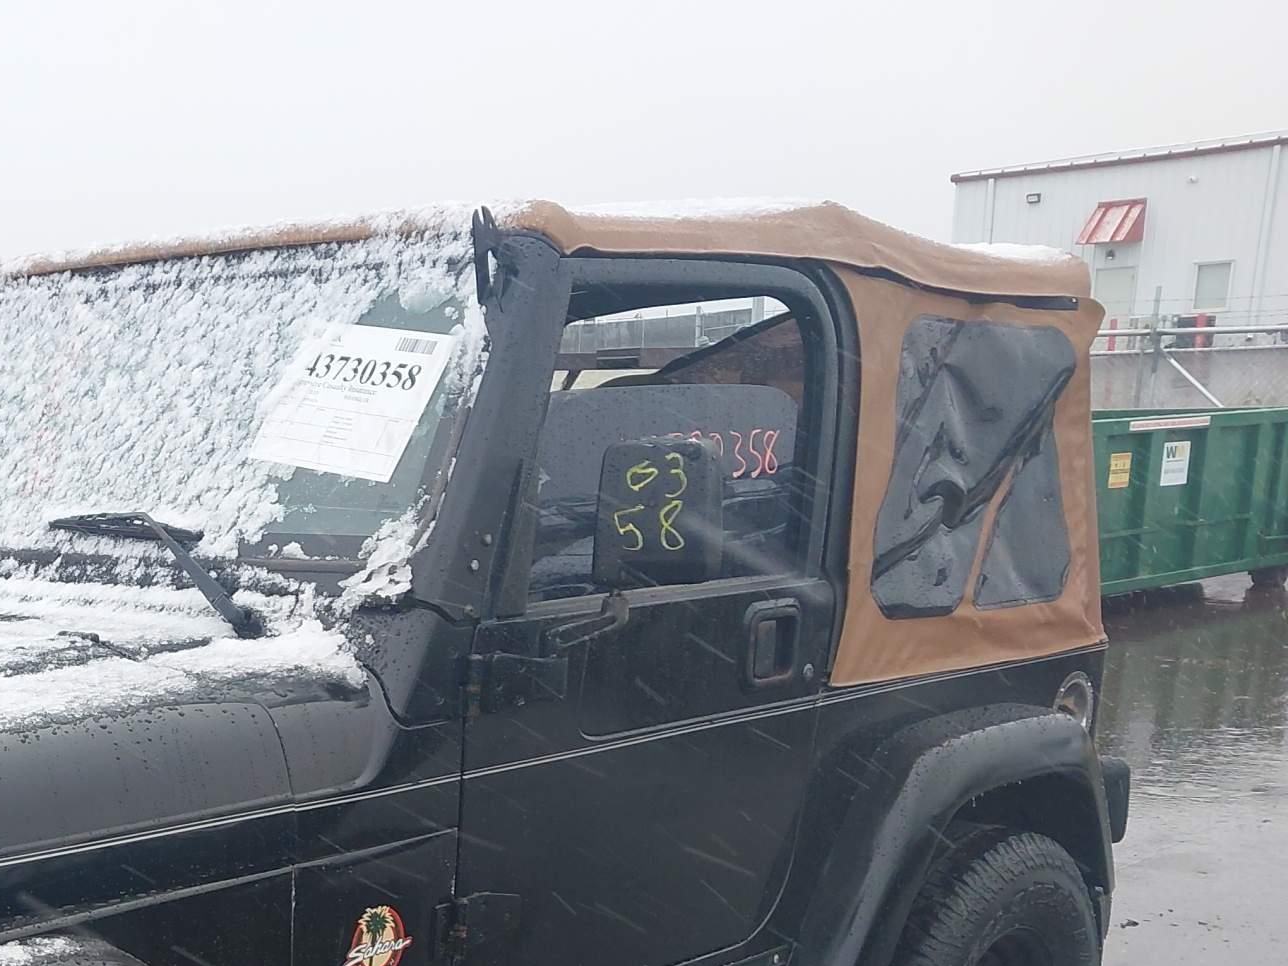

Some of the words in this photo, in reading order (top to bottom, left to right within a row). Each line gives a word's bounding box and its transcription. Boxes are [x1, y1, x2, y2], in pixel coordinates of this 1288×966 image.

[305, 353, 422, 391] 43730358
[626, 452, 688, 498] 03
[614, 500, 685, 551] 58
